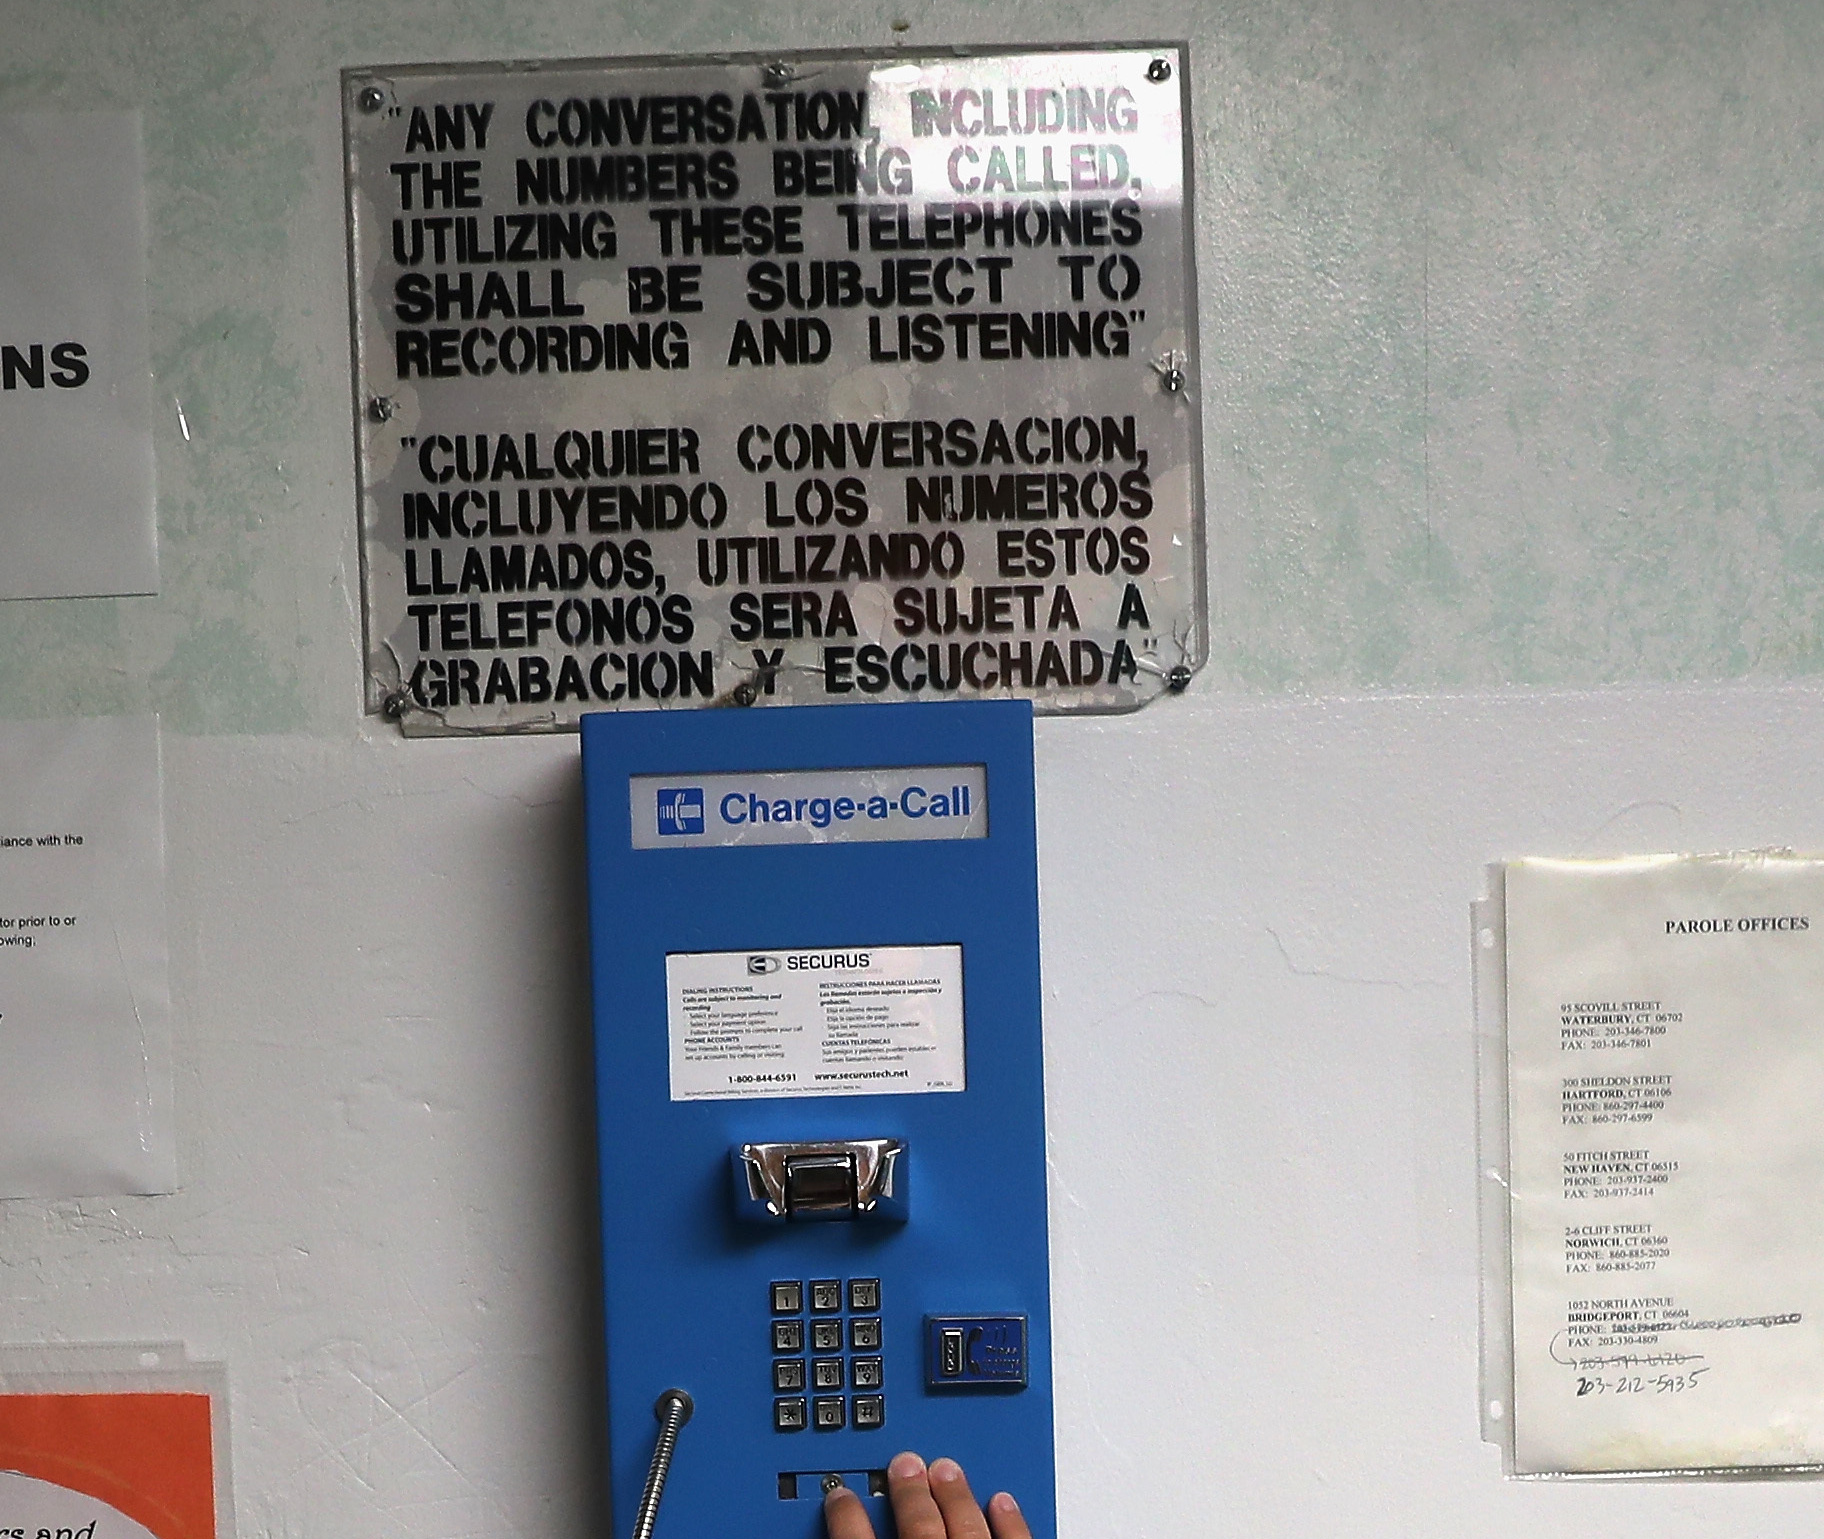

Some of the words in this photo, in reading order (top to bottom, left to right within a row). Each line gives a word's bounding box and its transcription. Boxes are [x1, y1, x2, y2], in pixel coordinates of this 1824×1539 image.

[401, 428, 699, 484] "CUALQUIER
[737, 416, 1148, 473] CONVERSACION,
[403, 482, 727, 540] INCLUYENDO
[766, 477, 868, 528] LOS
[906, 470, 1153, 524] NUMEROS
[405, 539, 665, 596] LLAMADOS,
[698, 531, 964, 586] UTILIZANDO
[997, 526, 1149, 578] ESTOS
[408, 594, 694, 651] TELEFONOS
[730, 590, 858, 642] SERA
[894, 585, 1080, 637] SUJETA
[1118, 583, 1149, 630] A
[411, 650, 714, 711] GRABACION
[754, 649, 784, 694] Y
[36, 834, 61, 847] with
[64, 833, 84, 846] the
[1665, 919, 1734, 934] PAROLE
[1737, 917, 1810, 932] OFFICES
[786, 953, 870, 971] SECURUS
[1562, 1014, 1634, 1026] WATERBURY,
[1636, 1013, 1651, 1024] CT
[727, 1073, 797, 1084] 1-800-844-6591
[814, 1068, 909, 1081] www.securustech.net
[1591, 1298, 1629, 1310] NORTH
[1630, 1297, 1674, 1309] AVENUE
